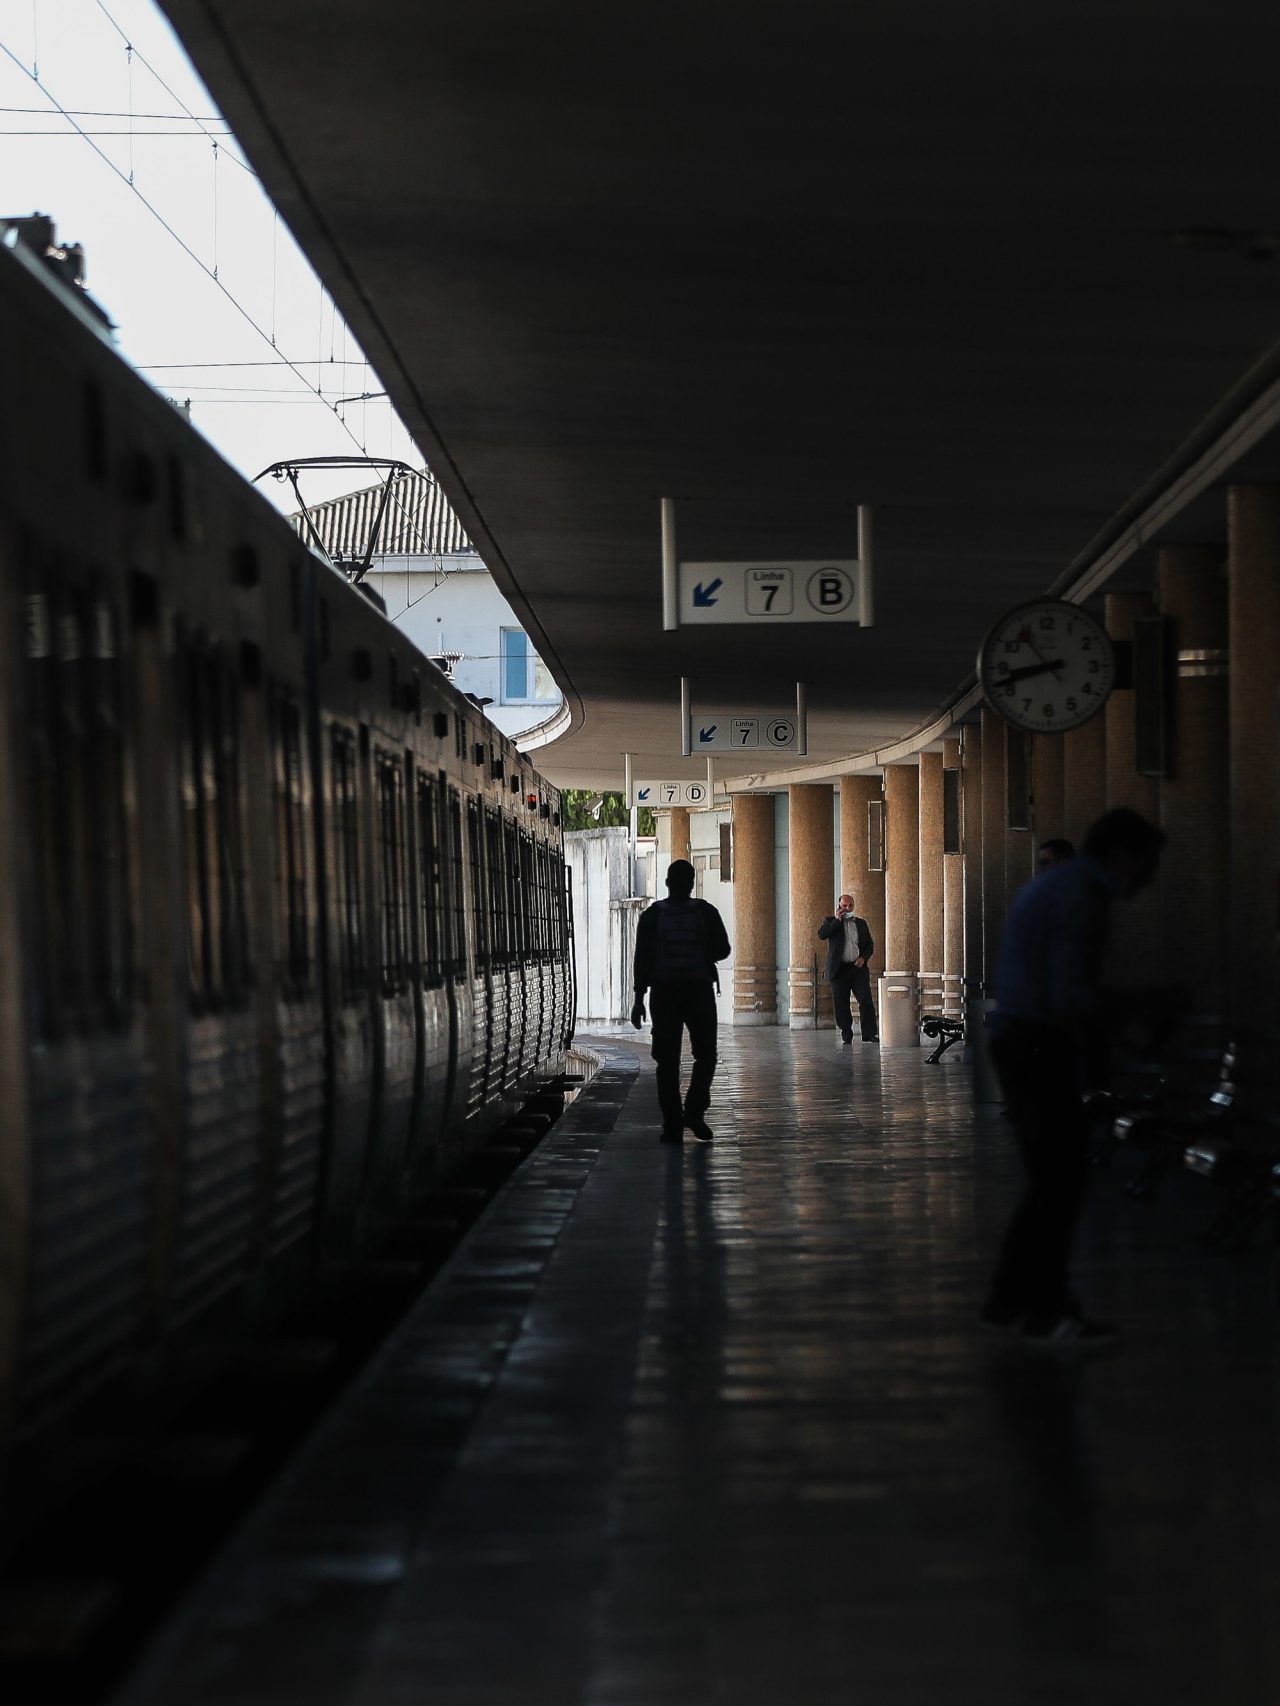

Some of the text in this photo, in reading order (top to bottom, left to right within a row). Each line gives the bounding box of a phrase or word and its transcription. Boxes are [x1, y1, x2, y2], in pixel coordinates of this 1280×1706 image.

[753, 572, 784, 581] Linha
[761, 578, 843, 611] 7 B
[1040, 617, 1054, 630] 12
[1067, 622, 1073, 635] 1
[1005, 640, 1019, 653] 10
[1081, 637, 1092, 650] 2
[998, 662, 1008, 674] 9
[1088, 660, 1099, 673] 3
[1005, 684, 1015, 697] 8
[1081, 682, 1092, 694] 4
[1022, 699, 1032, 711] 7
[1043, 704, 1054, 717] 6
[1066, 698, 1077, 711] 5
[740, 725, 788, 744] 7 C
[667, 788, 701, 802] 7 D
